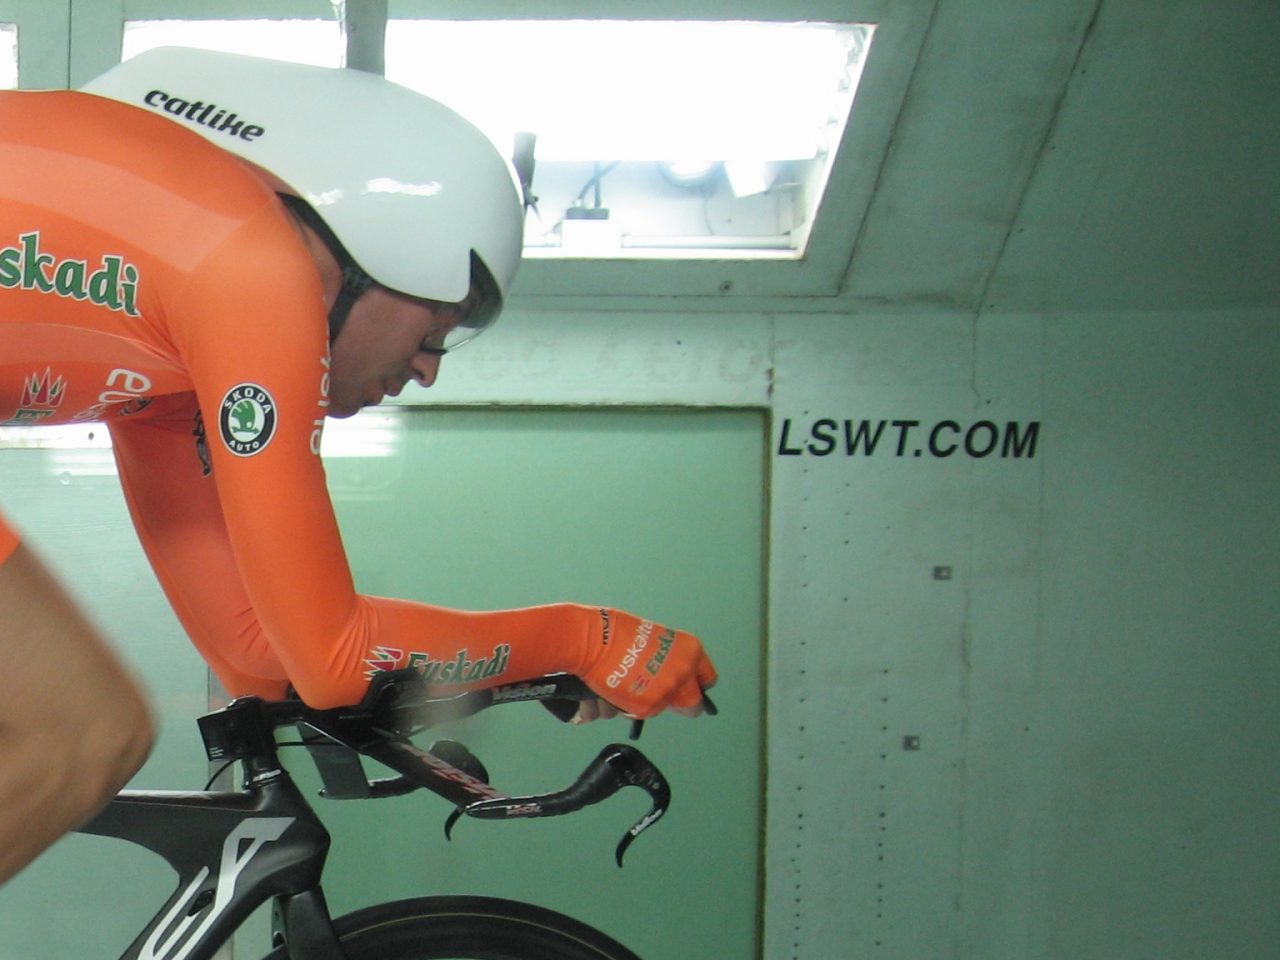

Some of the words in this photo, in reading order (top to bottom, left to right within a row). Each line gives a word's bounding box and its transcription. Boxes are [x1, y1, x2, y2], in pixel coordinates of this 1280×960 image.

[144, 89, 265, 142] catlike
[229, 440, 260, 451] AUTO
[777, 419, 1041, 459] LSWT.COM
[606, 619, 654, 688] euskalte
